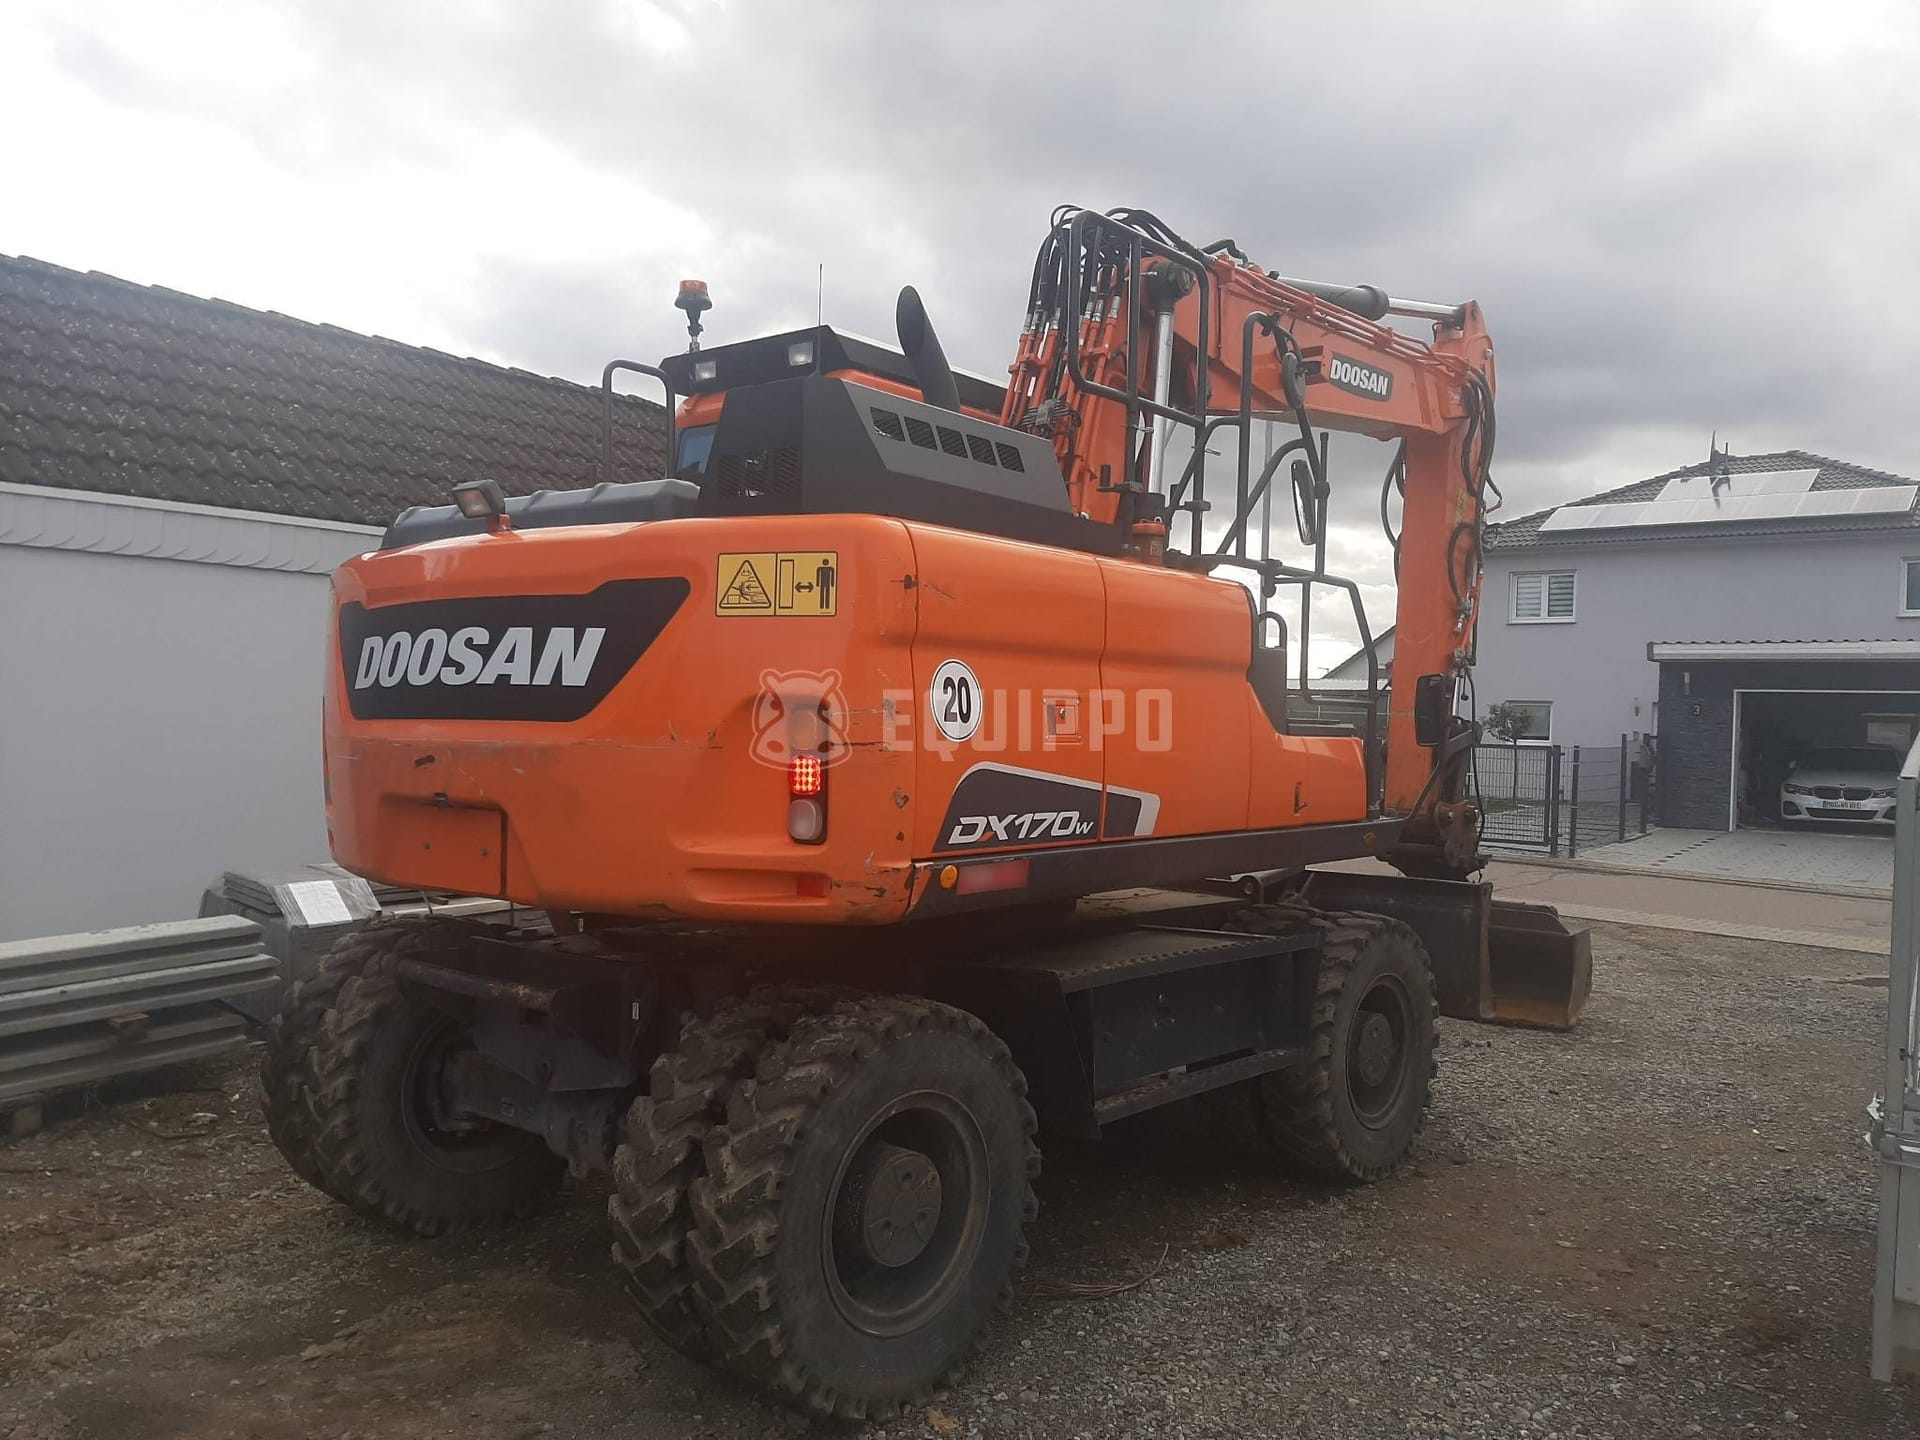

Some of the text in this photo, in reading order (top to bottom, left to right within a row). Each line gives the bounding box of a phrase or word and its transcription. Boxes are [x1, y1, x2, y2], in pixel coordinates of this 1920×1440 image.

[1330, 359, 1388, 395] DOOSAN
[354, 626, 606, 691] DOOSAN
[942, 676, 972, 724] 20
